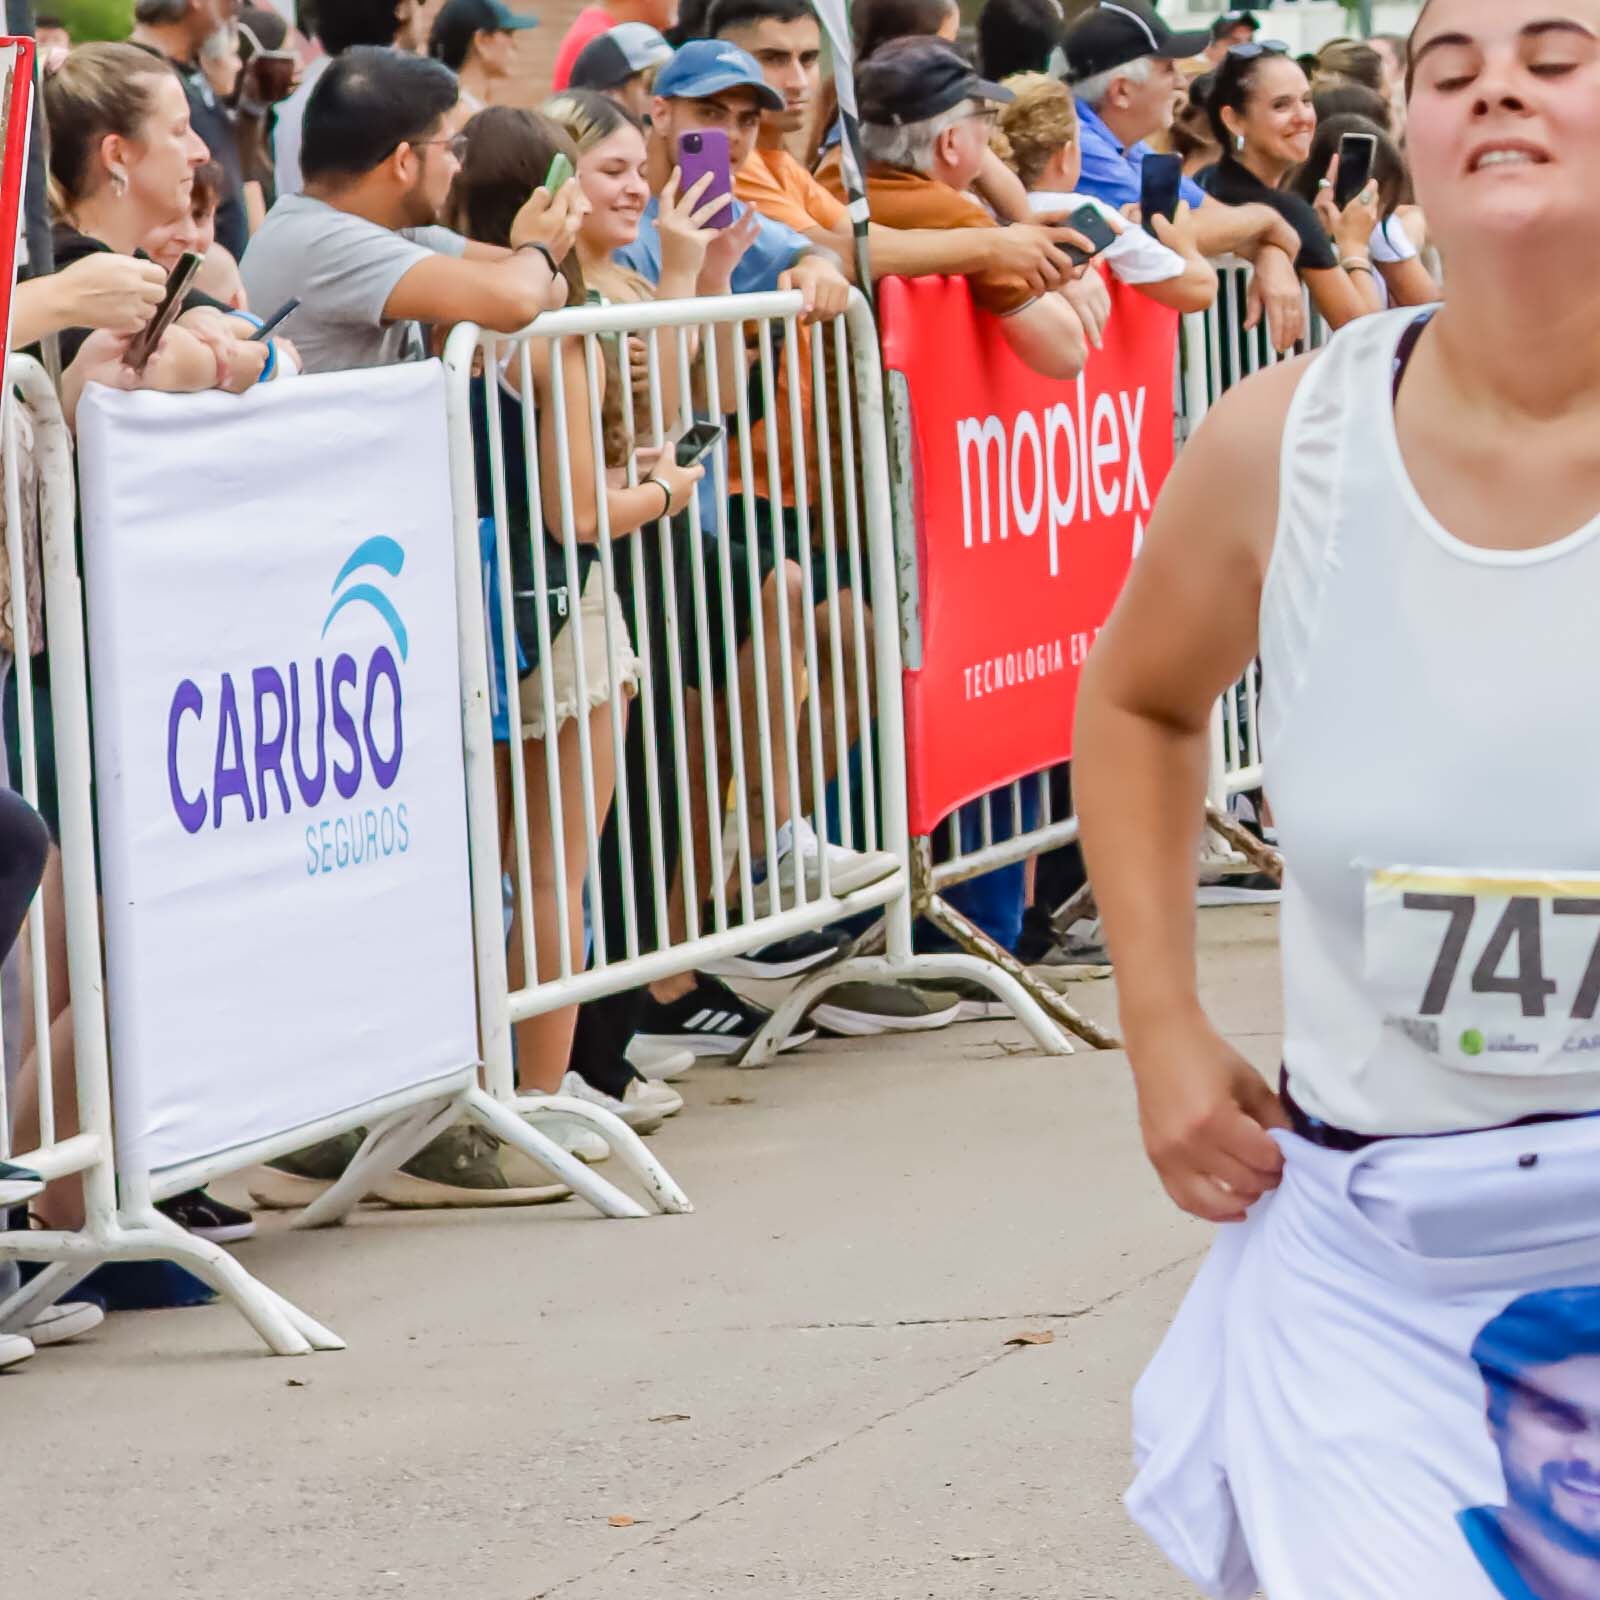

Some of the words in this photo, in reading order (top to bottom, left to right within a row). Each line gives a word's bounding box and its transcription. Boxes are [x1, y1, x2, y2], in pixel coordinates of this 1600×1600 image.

[956, 370, 1151, 577] moplex
[963, 639, 1064, 701] TECNOLOGIA
[167, 645, 403, 834] CARUSO
[304, 803, 410, 876] SEGUROS
